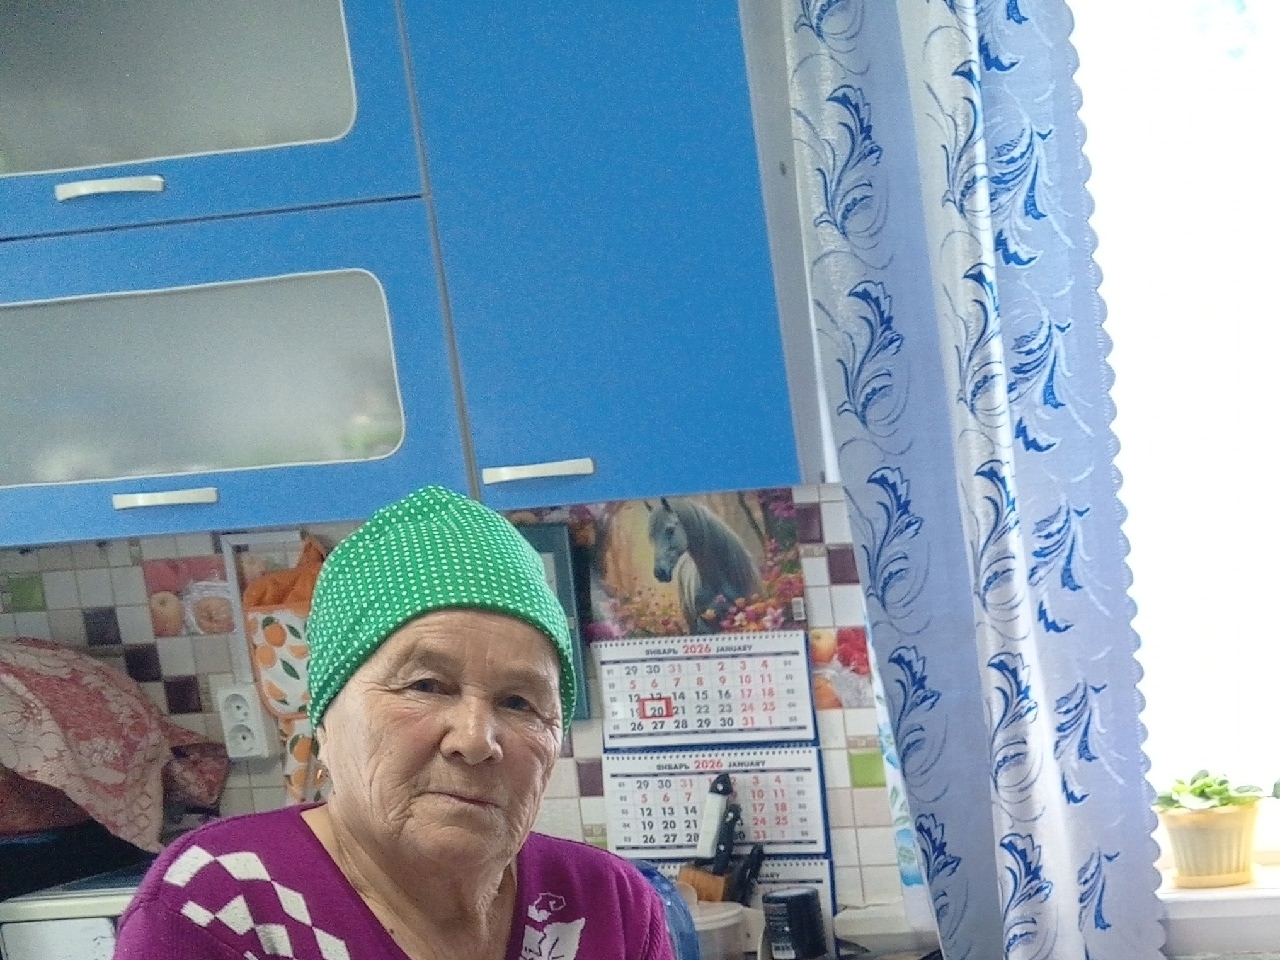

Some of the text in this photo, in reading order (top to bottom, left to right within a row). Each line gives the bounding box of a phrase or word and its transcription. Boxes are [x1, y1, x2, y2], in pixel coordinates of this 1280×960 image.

[682, 644, 711, 654] 2026
[716, 644, 752, 653] JANUARY
[625, 666, 638, 675] 29
[646, 665, 660, 674] 30
[668, 663, 682, 673] 31
[696, 663, 701, 672] 1
[718, 661, 725, 671] 2
[740, 660, 746, 670] 3
[761, 660, 768, 669] 4
[630, 680, 636, 690] 5
[651, 679, 658, 688] 6
[673, 677, 680, 687] 7
[696, 677, 704, 687] 8
[719, 675, 726, 685] 9
[740, 674, 751, 684] 10
[760, 673, 772, 683] 11
[672, 691, 685, 700] 14
[695, 690, 708, 700] 15
[718, 689, 731, 699] 16
[741, 689, 752, 698] 17
[762, 687, 774, 697] 18
[650, 706, 663, 716] 20
[672, 706, 685, 714] 21
[695, 705, 709, 714] 22
[741, 702, 753, 712] 24
[762, 701, 775, 711] 25
[631, 721, 643, 731] 26
[652, 721, 665, 729] 27
[674, 719, 687, 729] 28
[697, 718, 711, 728] 29
[720, 717, 733, 726] 30
[742, 716, 754, 726] 31
[768, 716, 772, 725] 1
[656, 759, 765, 770] ЯНВАРЬ 2026 JANUARY
[636, 780, 649, 789] 29
[658, 779, 671, 789] 30
[752, 775, 759, 785] 3
[775, 775, 781, 784] 4
[641, 793, 648, 803] 5
[663, 793, 670, 803] 6
[685, 792, 692, 801] 7
[751, 789, 763, 799] 10
[774, 788, 785, 798] 11
[640, 807, 652, 816] 12
[662, 807, 675, 816] 13
[684, 806, 697, 815] 14
[752, 803, 765, 813] 17
[774, 802, 787, 812] 18
[641, 821, 653, 830] 19
[662, 820, 676, 829] 20
[684, 820, 697, 829] 21
[752, 816, 766, 826] 24
[775, 816, 788, 826] 25
[642, 834, 655, 843] 26
[664, 833, 677, 842] 27
[686, 833, 699, 842] 28
